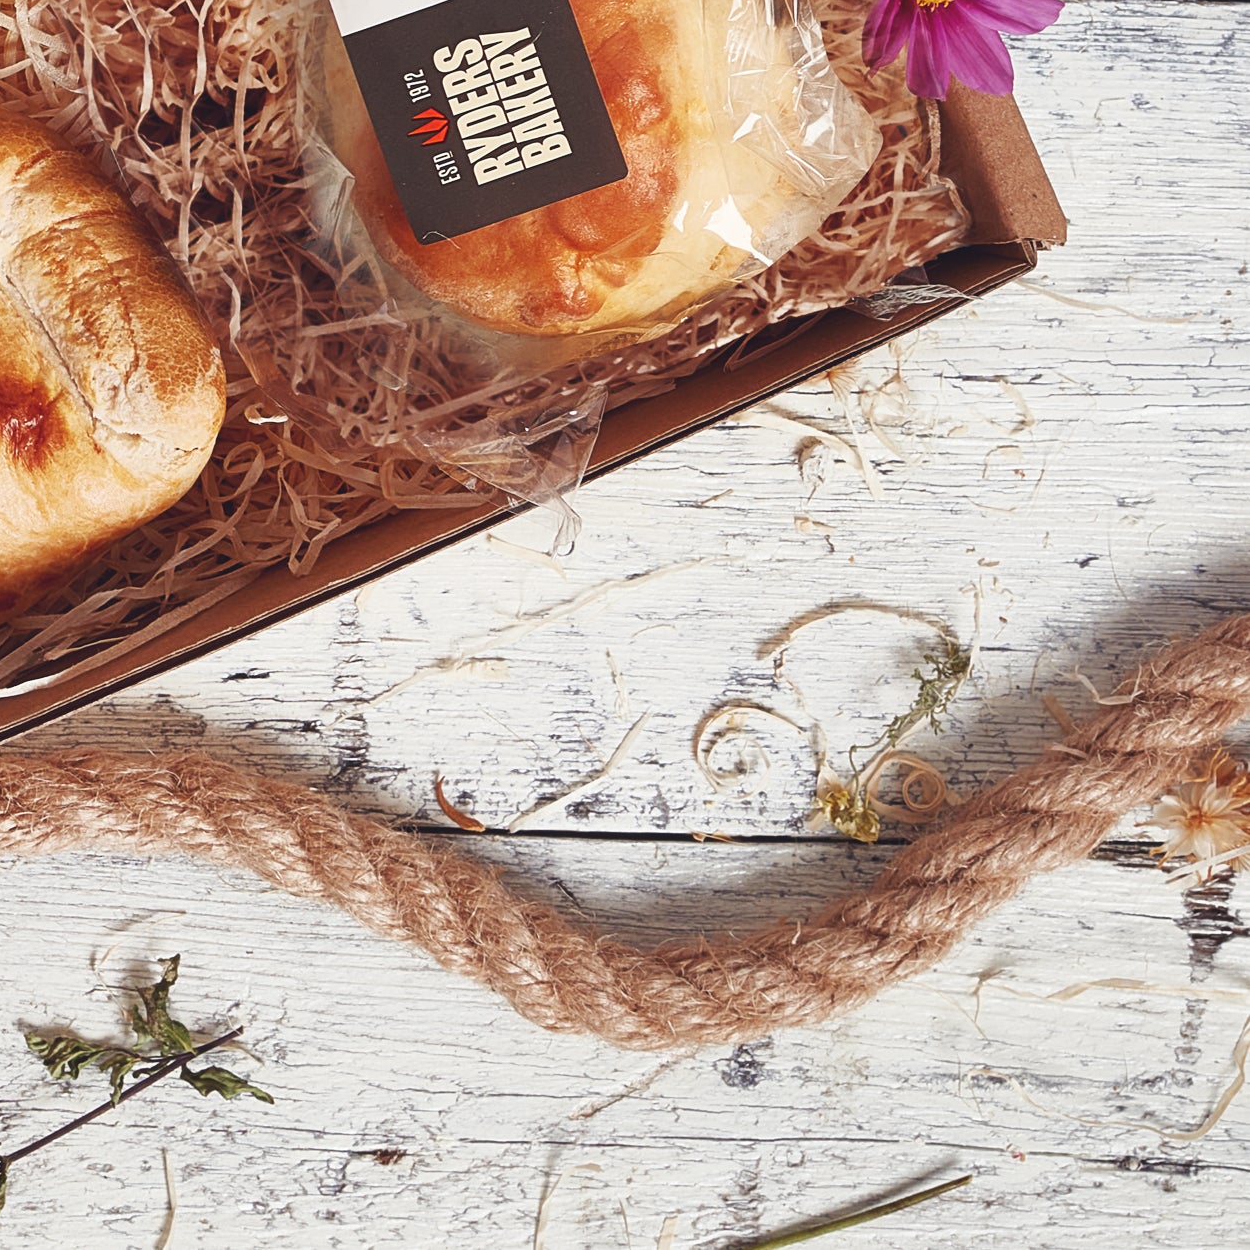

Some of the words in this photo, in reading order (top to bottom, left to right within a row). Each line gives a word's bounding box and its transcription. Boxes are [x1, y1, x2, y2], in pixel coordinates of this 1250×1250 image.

[404, 69, 431, 102] 1972
[434, 39, 524, 185] RYDERS
[479, 27, 572, 168] BAKERY
[433, 151, 460, 184] ESTD
